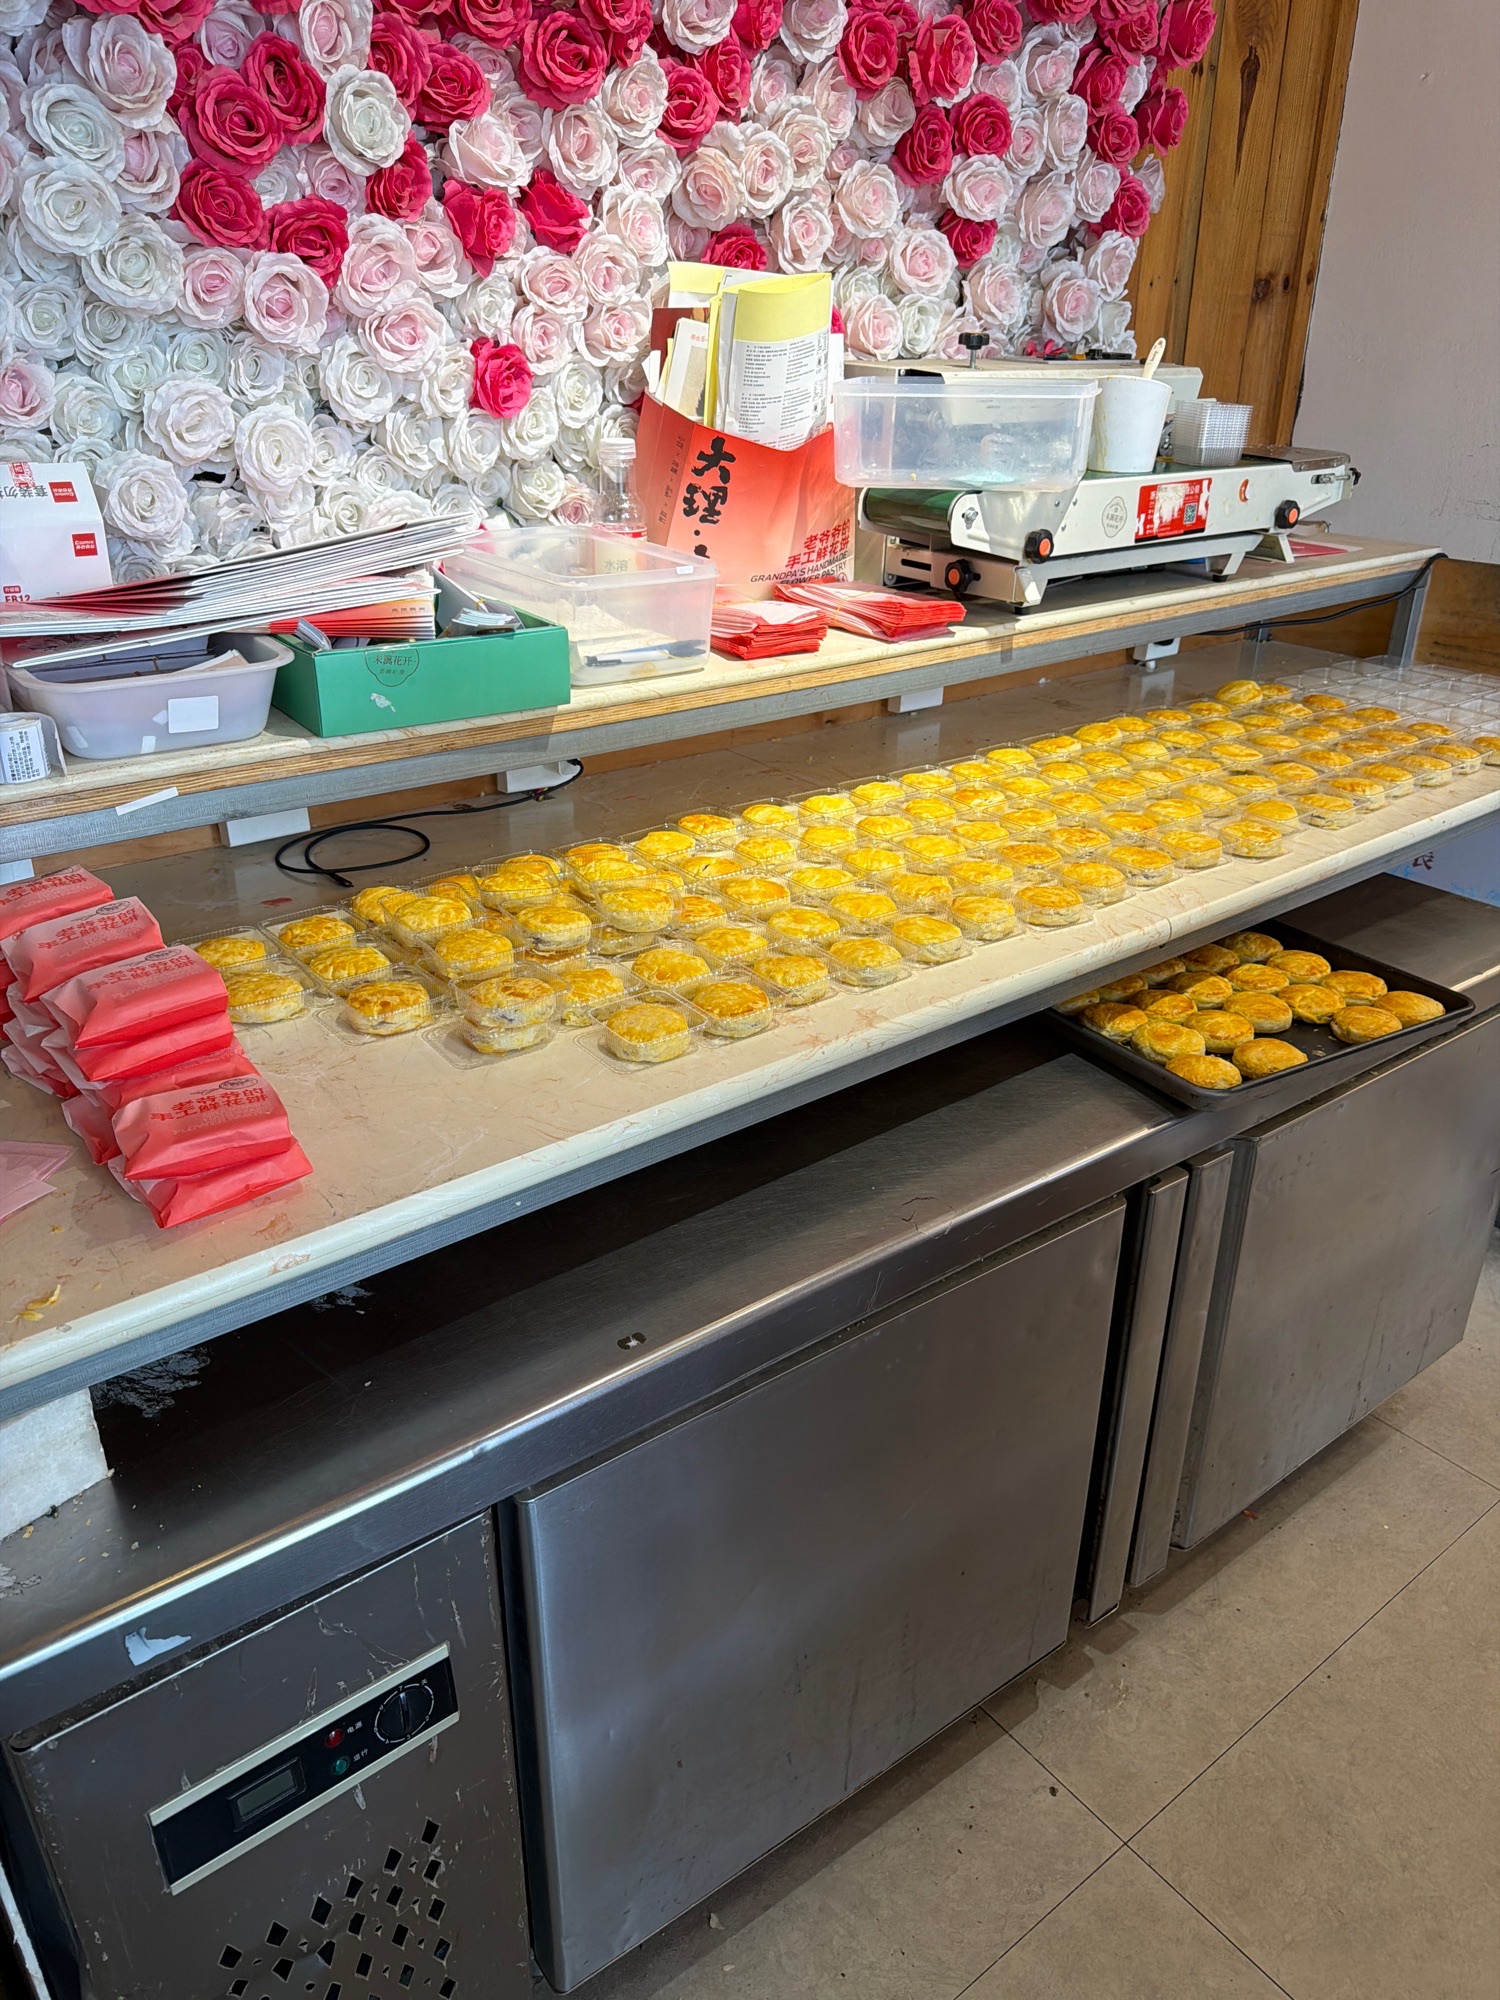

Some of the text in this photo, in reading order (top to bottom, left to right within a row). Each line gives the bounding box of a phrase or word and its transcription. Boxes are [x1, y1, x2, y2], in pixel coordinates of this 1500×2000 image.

[803, 518, 851, 550] 老爷爷的
[750, 550, 848, 583] GRANDPA'S HANDMADE
[785, 535, 850, 569] 手工鲜花饼
[38, 914, 139, 950] 手工鲜花饼
[56, 908, 135, 938] 老爷爷的
[86, 960, 196, 992] 手工鲜花饼
[103, 955, 191, 979] 老爷爷的
[151, 1095, 268, 1121] 手工鲜花饼
[171, 1088, 265, 1110] 老爷爷的
